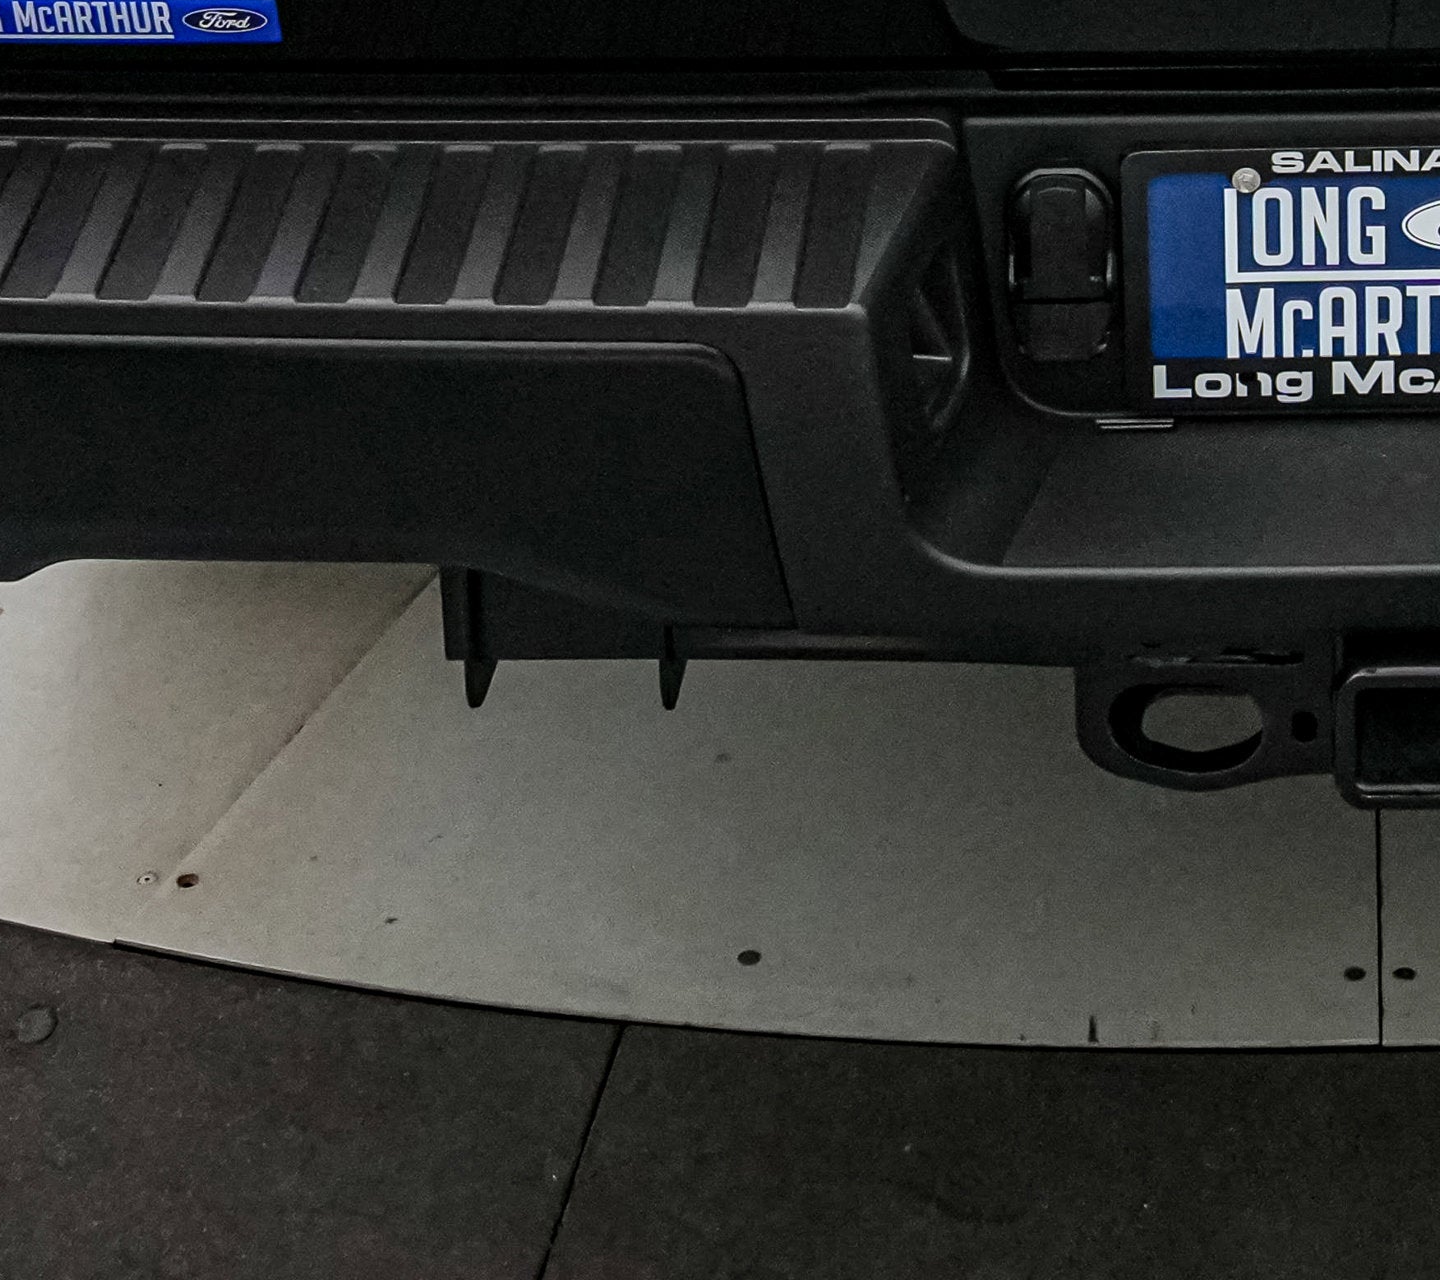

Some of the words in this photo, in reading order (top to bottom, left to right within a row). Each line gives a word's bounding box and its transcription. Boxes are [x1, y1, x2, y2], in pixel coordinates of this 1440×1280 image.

[13, 0, 174, 34] McARTHUR
[198, 11, 251, 30] Ford
[1224, 185, 1387, 284] LONG
[1152, 365, 1315, 403] Long
